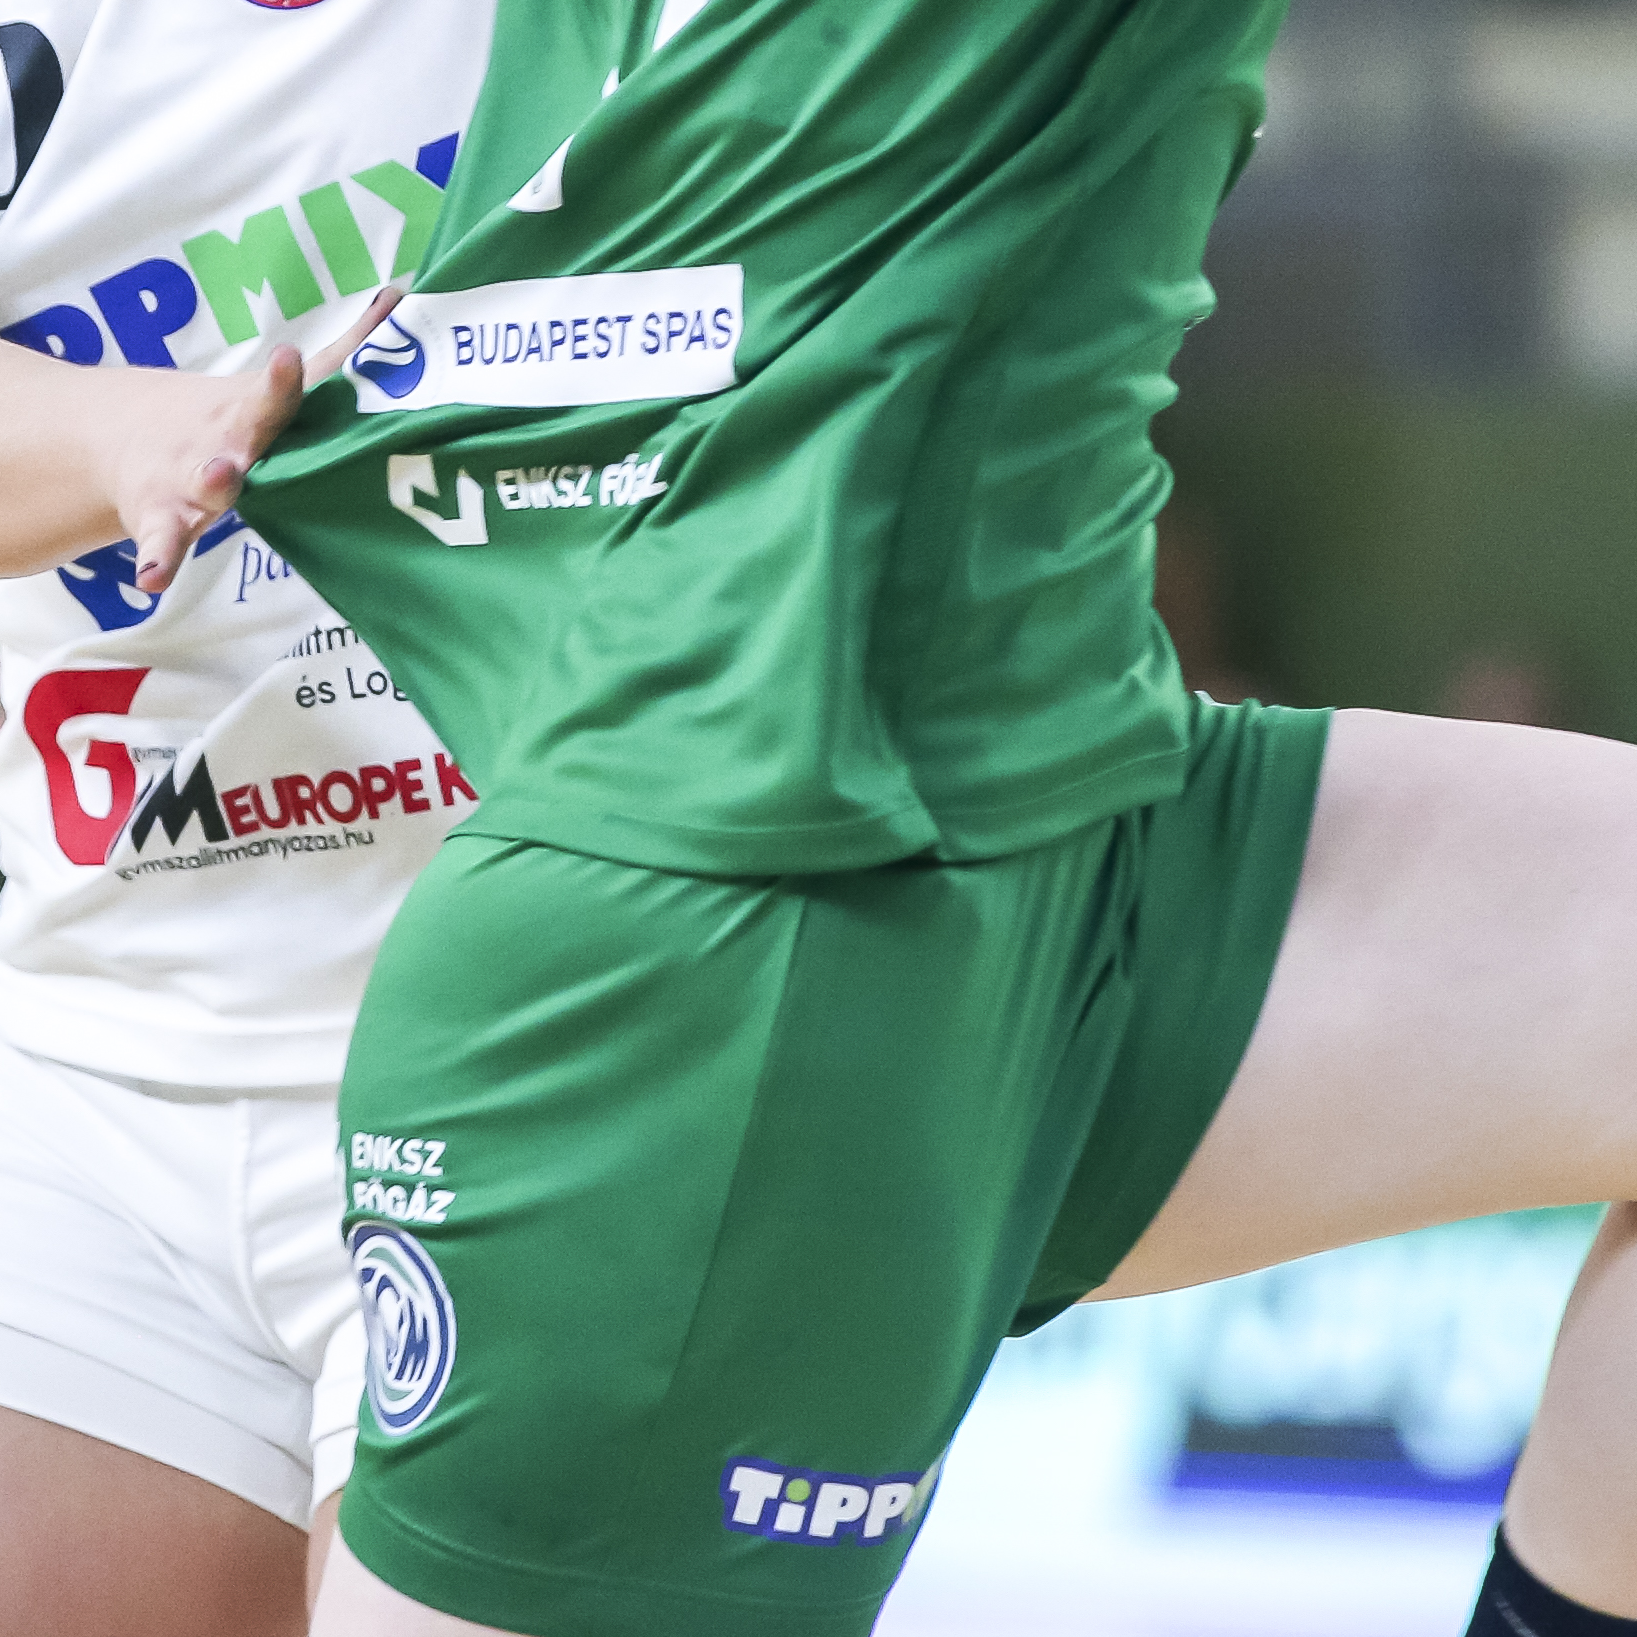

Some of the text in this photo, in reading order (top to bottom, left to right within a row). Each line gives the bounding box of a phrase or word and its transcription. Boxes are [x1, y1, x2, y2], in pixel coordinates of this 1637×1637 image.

[450, 306, 734, 367] BUDAPEST SPAS
[295, 674, 337, 709] és
[220, 758, 431, 837] EUROPE
